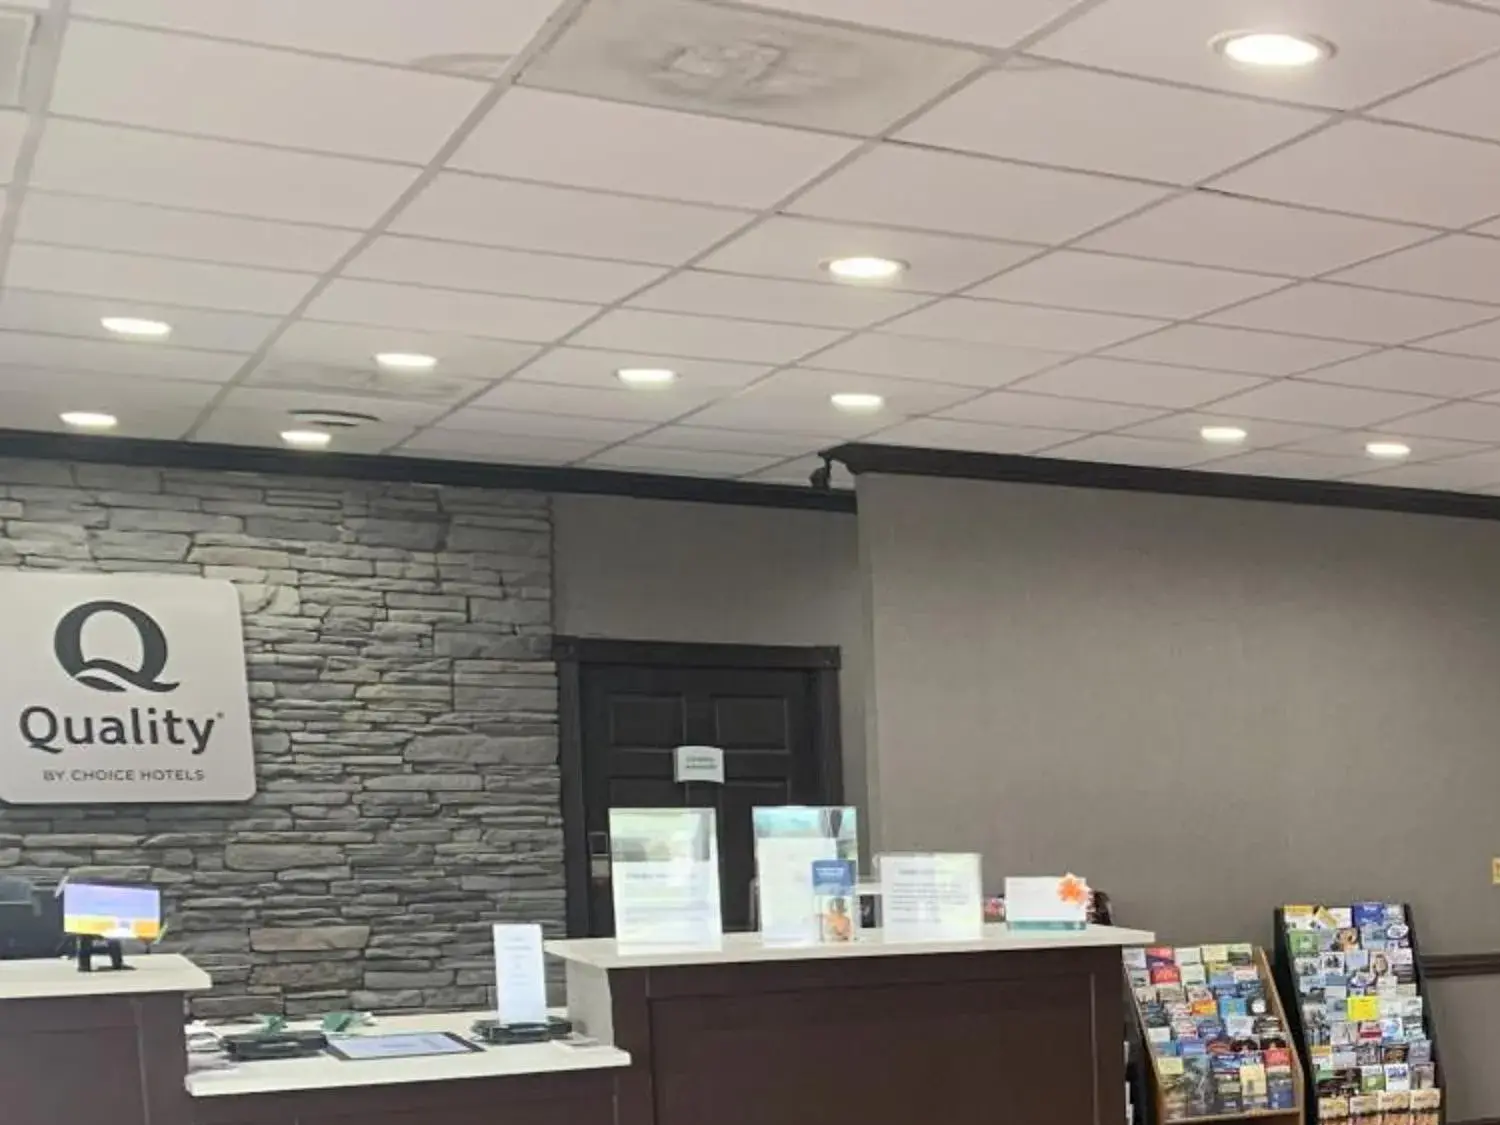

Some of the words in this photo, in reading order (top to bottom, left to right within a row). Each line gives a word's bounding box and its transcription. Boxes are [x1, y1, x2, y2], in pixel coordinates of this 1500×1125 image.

[54, 599, 181, 692] Q
[19, 705, 216, 755] Quality
[43, 769, 66, 781] BY
[71, 769, 135, 781] CHOICE
[140, 769, 206, 781] HOTELS
